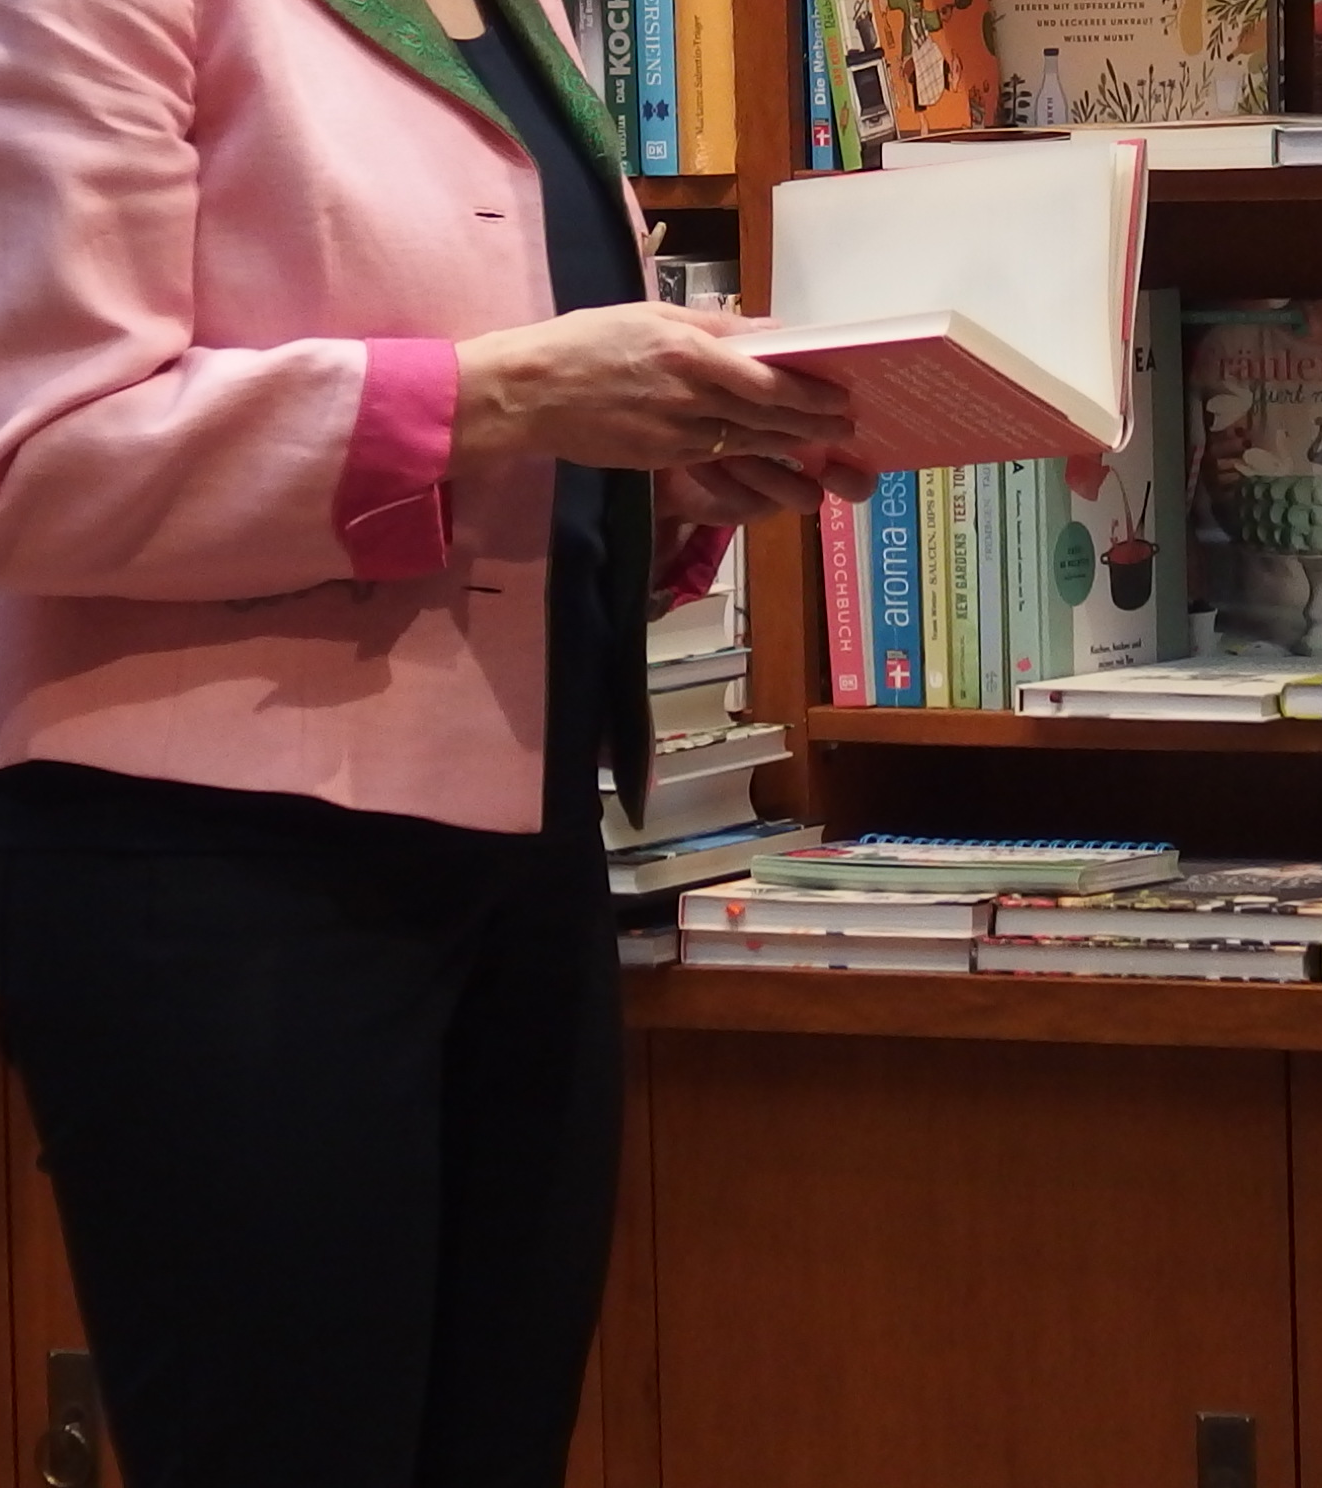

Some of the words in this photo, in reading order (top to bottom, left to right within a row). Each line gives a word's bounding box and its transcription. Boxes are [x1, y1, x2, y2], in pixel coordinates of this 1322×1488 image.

[616, 79, 625, 103] DAS
[830, 494, 843, 531] DAS
[834, 541, 851, 652] KOCHBUCH
[882, 525, 910, 628] aroma
